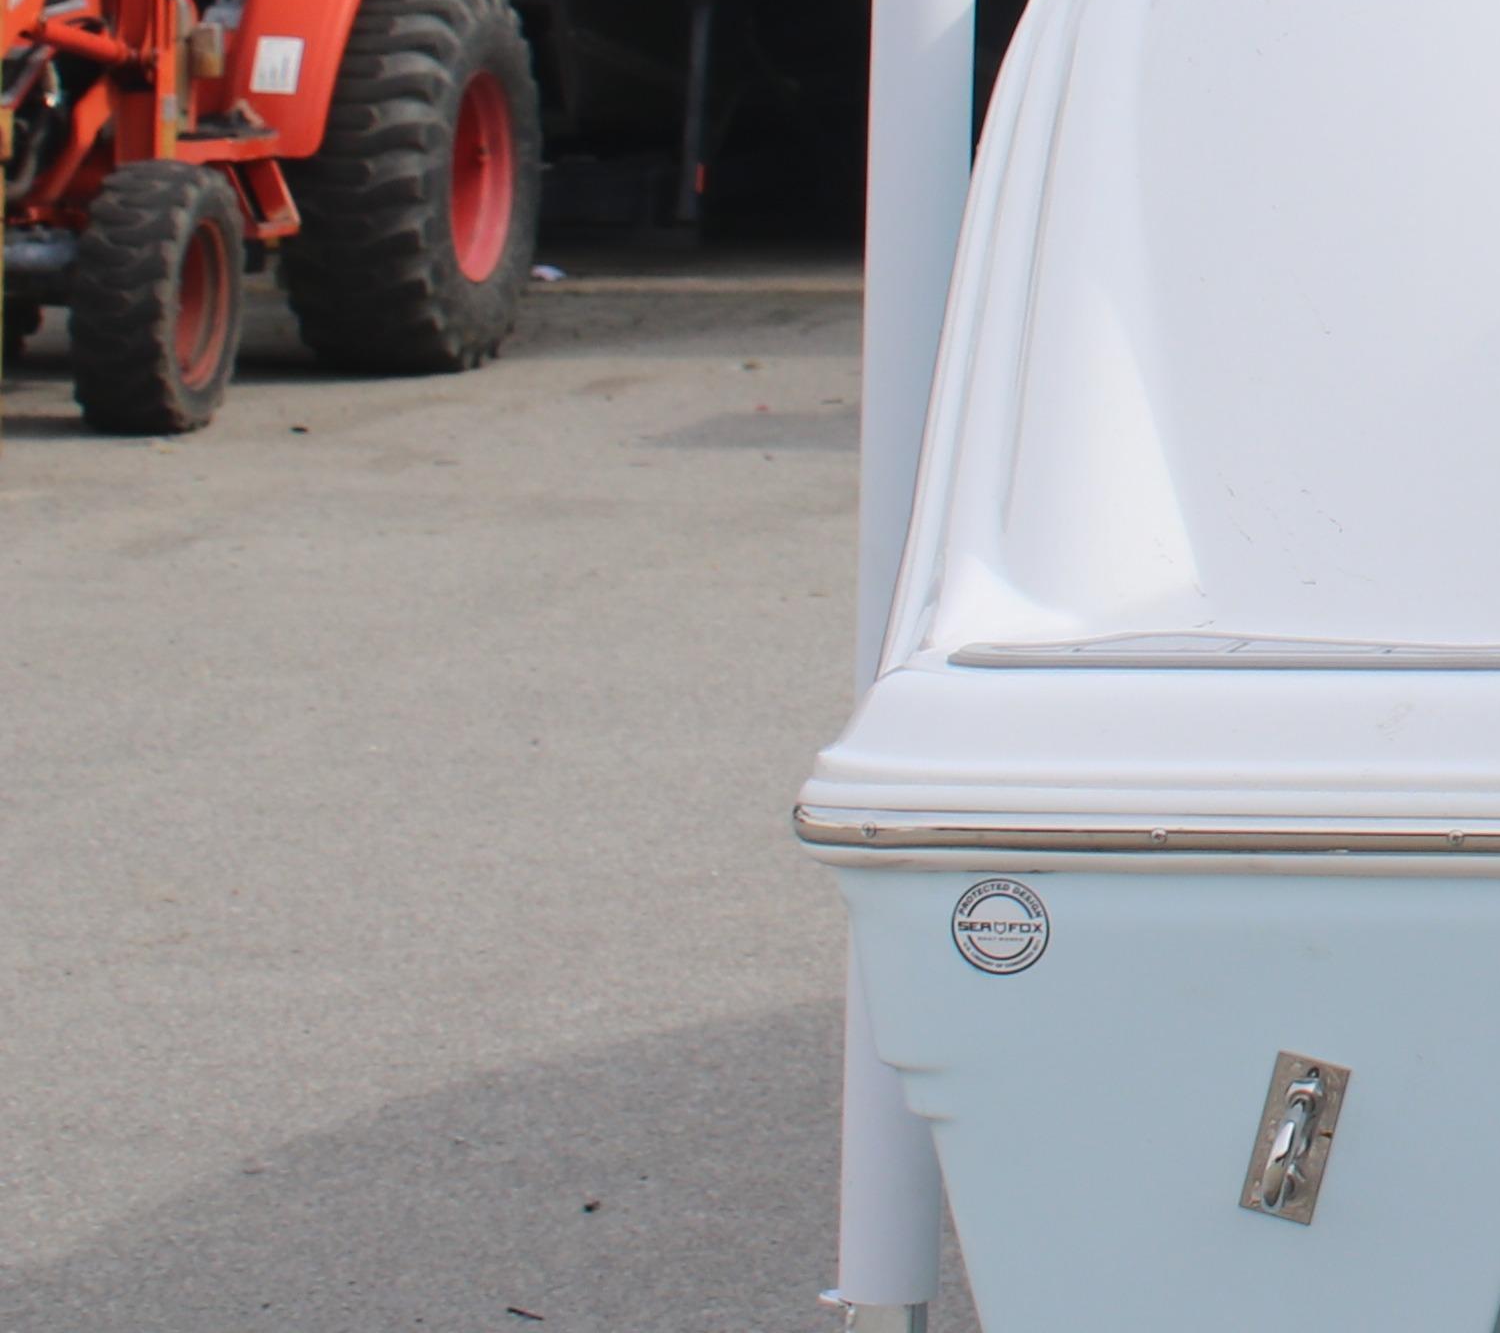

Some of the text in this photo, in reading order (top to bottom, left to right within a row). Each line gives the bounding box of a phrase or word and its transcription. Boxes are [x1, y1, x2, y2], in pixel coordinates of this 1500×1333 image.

[959, 883, 1009, 915] PROTECTED
[1012, 887, 1042, 918] DESIGN
[1009, 923, 1042, 933] FOX
